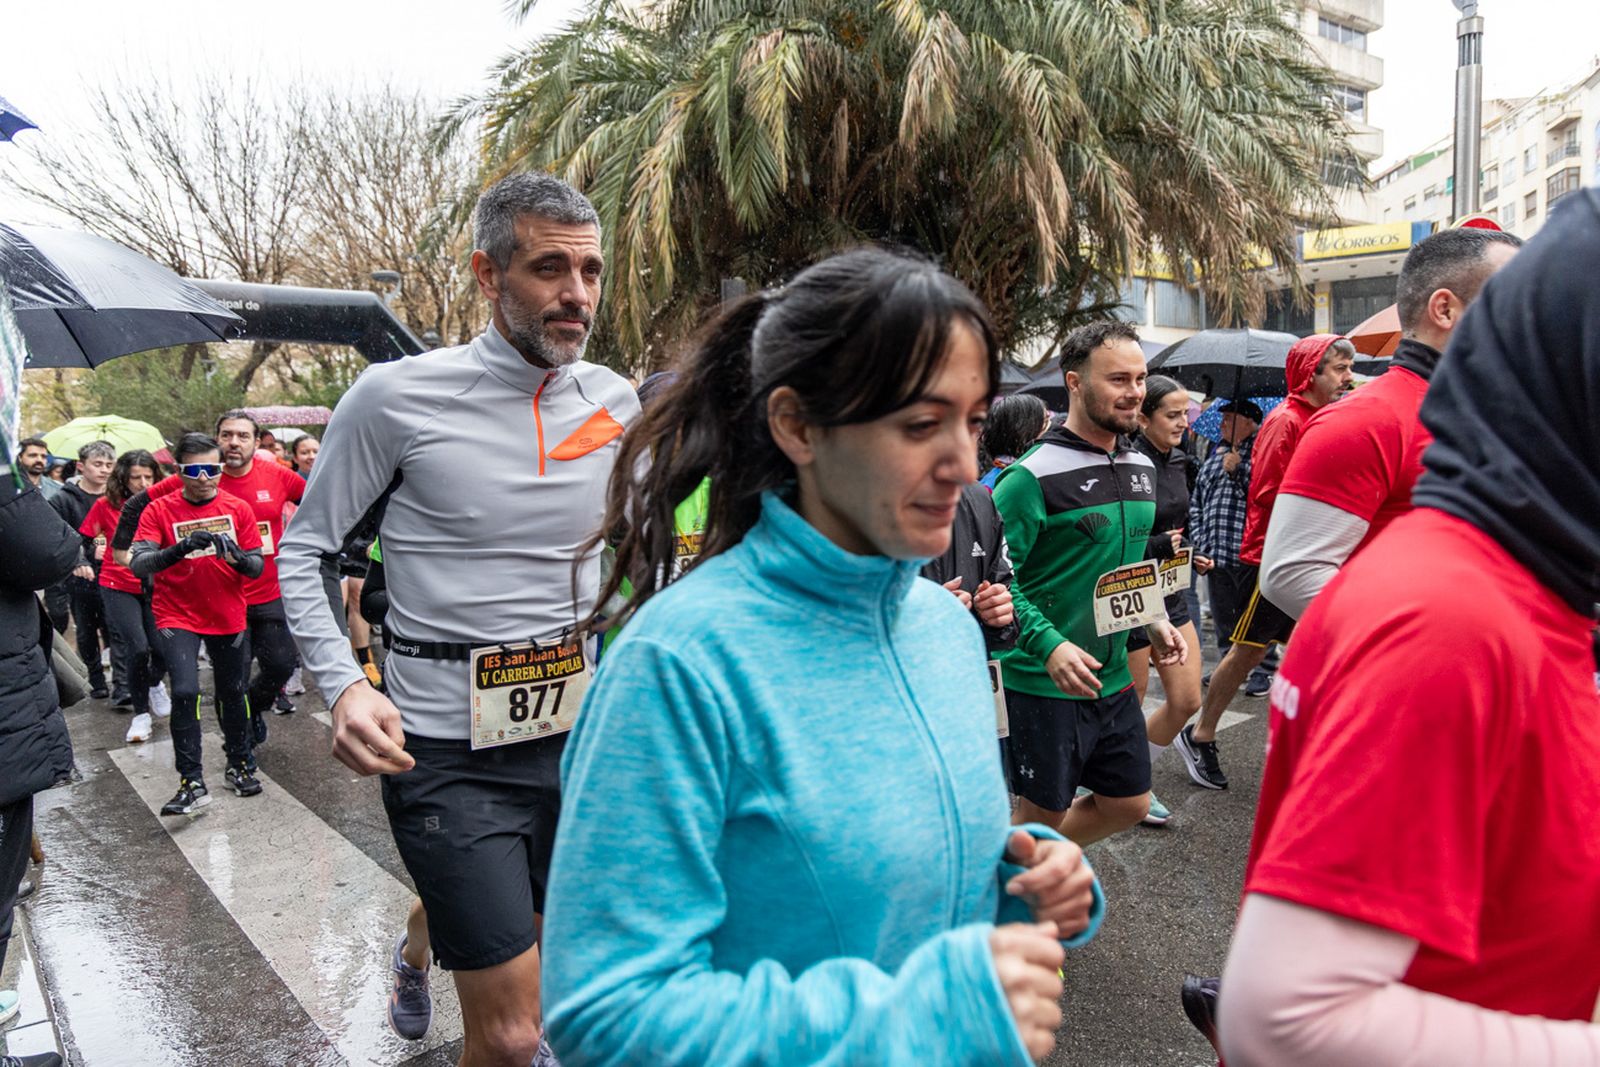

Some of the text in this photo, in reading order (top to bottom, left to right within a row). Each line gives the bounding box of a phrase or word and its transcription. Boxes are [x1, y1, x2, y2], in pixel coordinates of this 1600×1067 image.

[1333, 233, 1400, 250] CORREOS
[245, 300, 260, 311] de
[1127, 575, 1155, 589] POPULAR
[1110, 591, 1144, 618] 620
[484, 655, 501, 669] IES
[481, 656, 582, 686] V CARRERA POPULAR
[509, 680, 567, 722] 877
